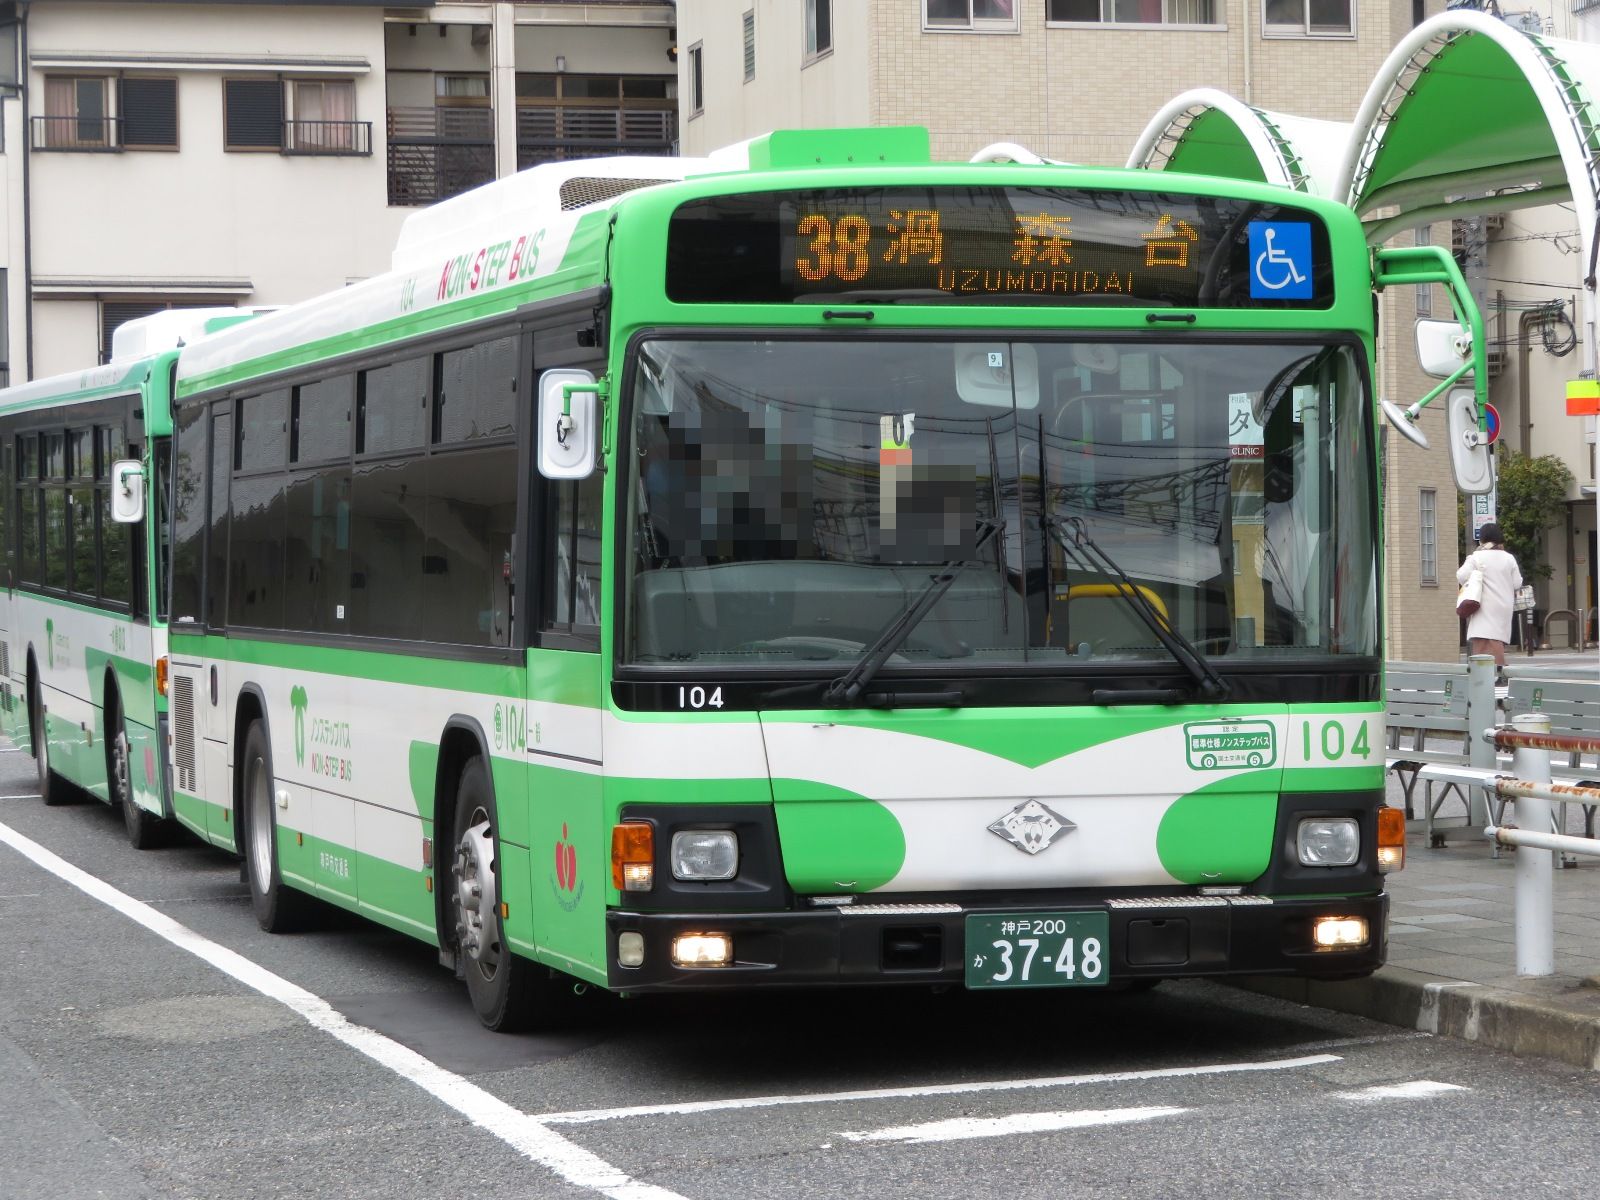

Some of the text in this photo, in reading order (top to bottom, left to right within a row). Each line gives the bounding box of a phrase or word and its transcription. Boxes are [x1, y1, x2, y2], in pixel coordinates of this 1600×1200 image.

[438, 228, 546, 300] NON-STEP BUS
[796, 210, 1198, 281] 38 渦森台
[939, 270, 1133, 292] UZUMORIDAI
[1231, 447, 1260, 456] CLINIC
[679, 686, 724, 709] 104
[505, 704, 526, 754] 104
[1302, 719, 1371, 761] 104
[340, 758, 352, 782] BUS
[974, 937, 1102, 981] か 37-48
